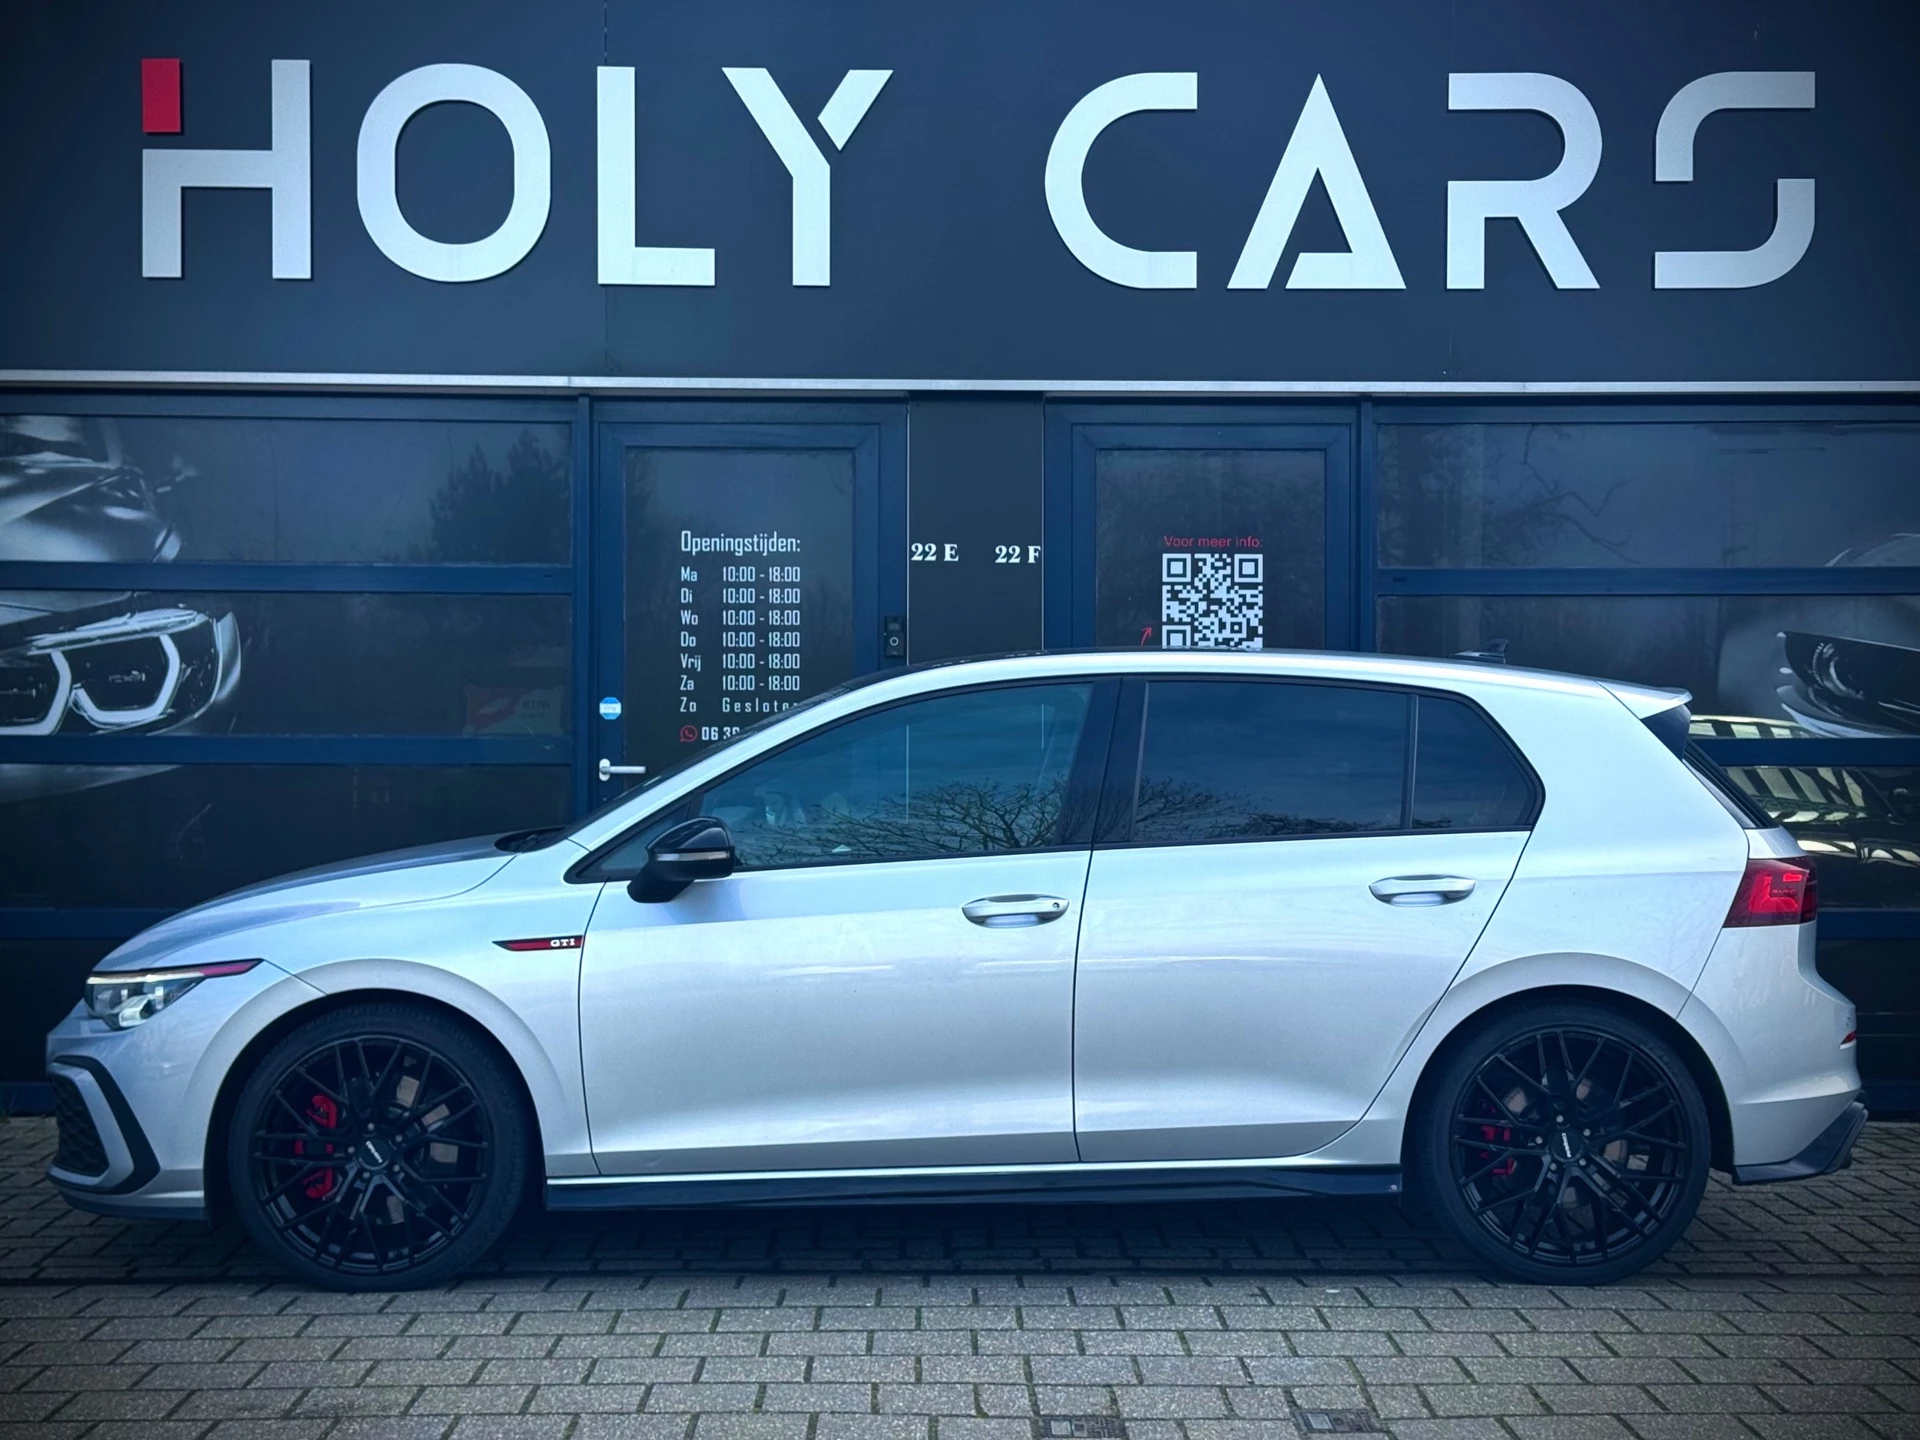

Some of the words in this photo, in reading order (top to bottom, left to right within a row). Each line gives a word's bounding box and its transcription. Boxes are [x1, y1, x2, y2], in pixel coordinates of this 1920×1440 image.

[141, 57, 895, 288] HOLY
[1043, 71, 1817, 291] CARS
[680, 530, 802, 557] Openingstijden:
[1163, 535, 1194, 548] Voor
[1198, 537, 1232, 548] meer
[1235, 535, 1264, 548] info:
[910, 542, 937, 562] 22
[943, 543, 959, 562] E
[994, 544, 1021, 564] 22
[1027, 545, 1042, 564] F
[681, 566, 698, 582] Ma
[722, 566, 756, 582] 10:00
[768, 566, 801, 582] 18:00
[681, 588, 693, 604] Di
[722, 588, 756, 604] 10:00
[768, 588, 801, 604] 18:00
[680, 609, 699, 625] Wo
[722, 609, 756, 625] 10:00
[768, 609, 801, 625] 18:00
[680, 631, 697, 647] Do
[722, 631, 756, 647] 10:00
[768, 631, 801, 647] 18:00
[680, 653, 702, 672] Vrij
[722, 653, 756, 669] 10:00
[768, 653, 801, 669] 18:00
[680, 675, 695, 691] Za
[722, 675, 756, 691] 10:00
[768, 675, 801, 691] 18:00
[680, 696, 697, 713] Zo
[722, 696, 798, 713] Geslote
[701, 726, 719, 741] 06
[550, 938, 576, 948] GTI
